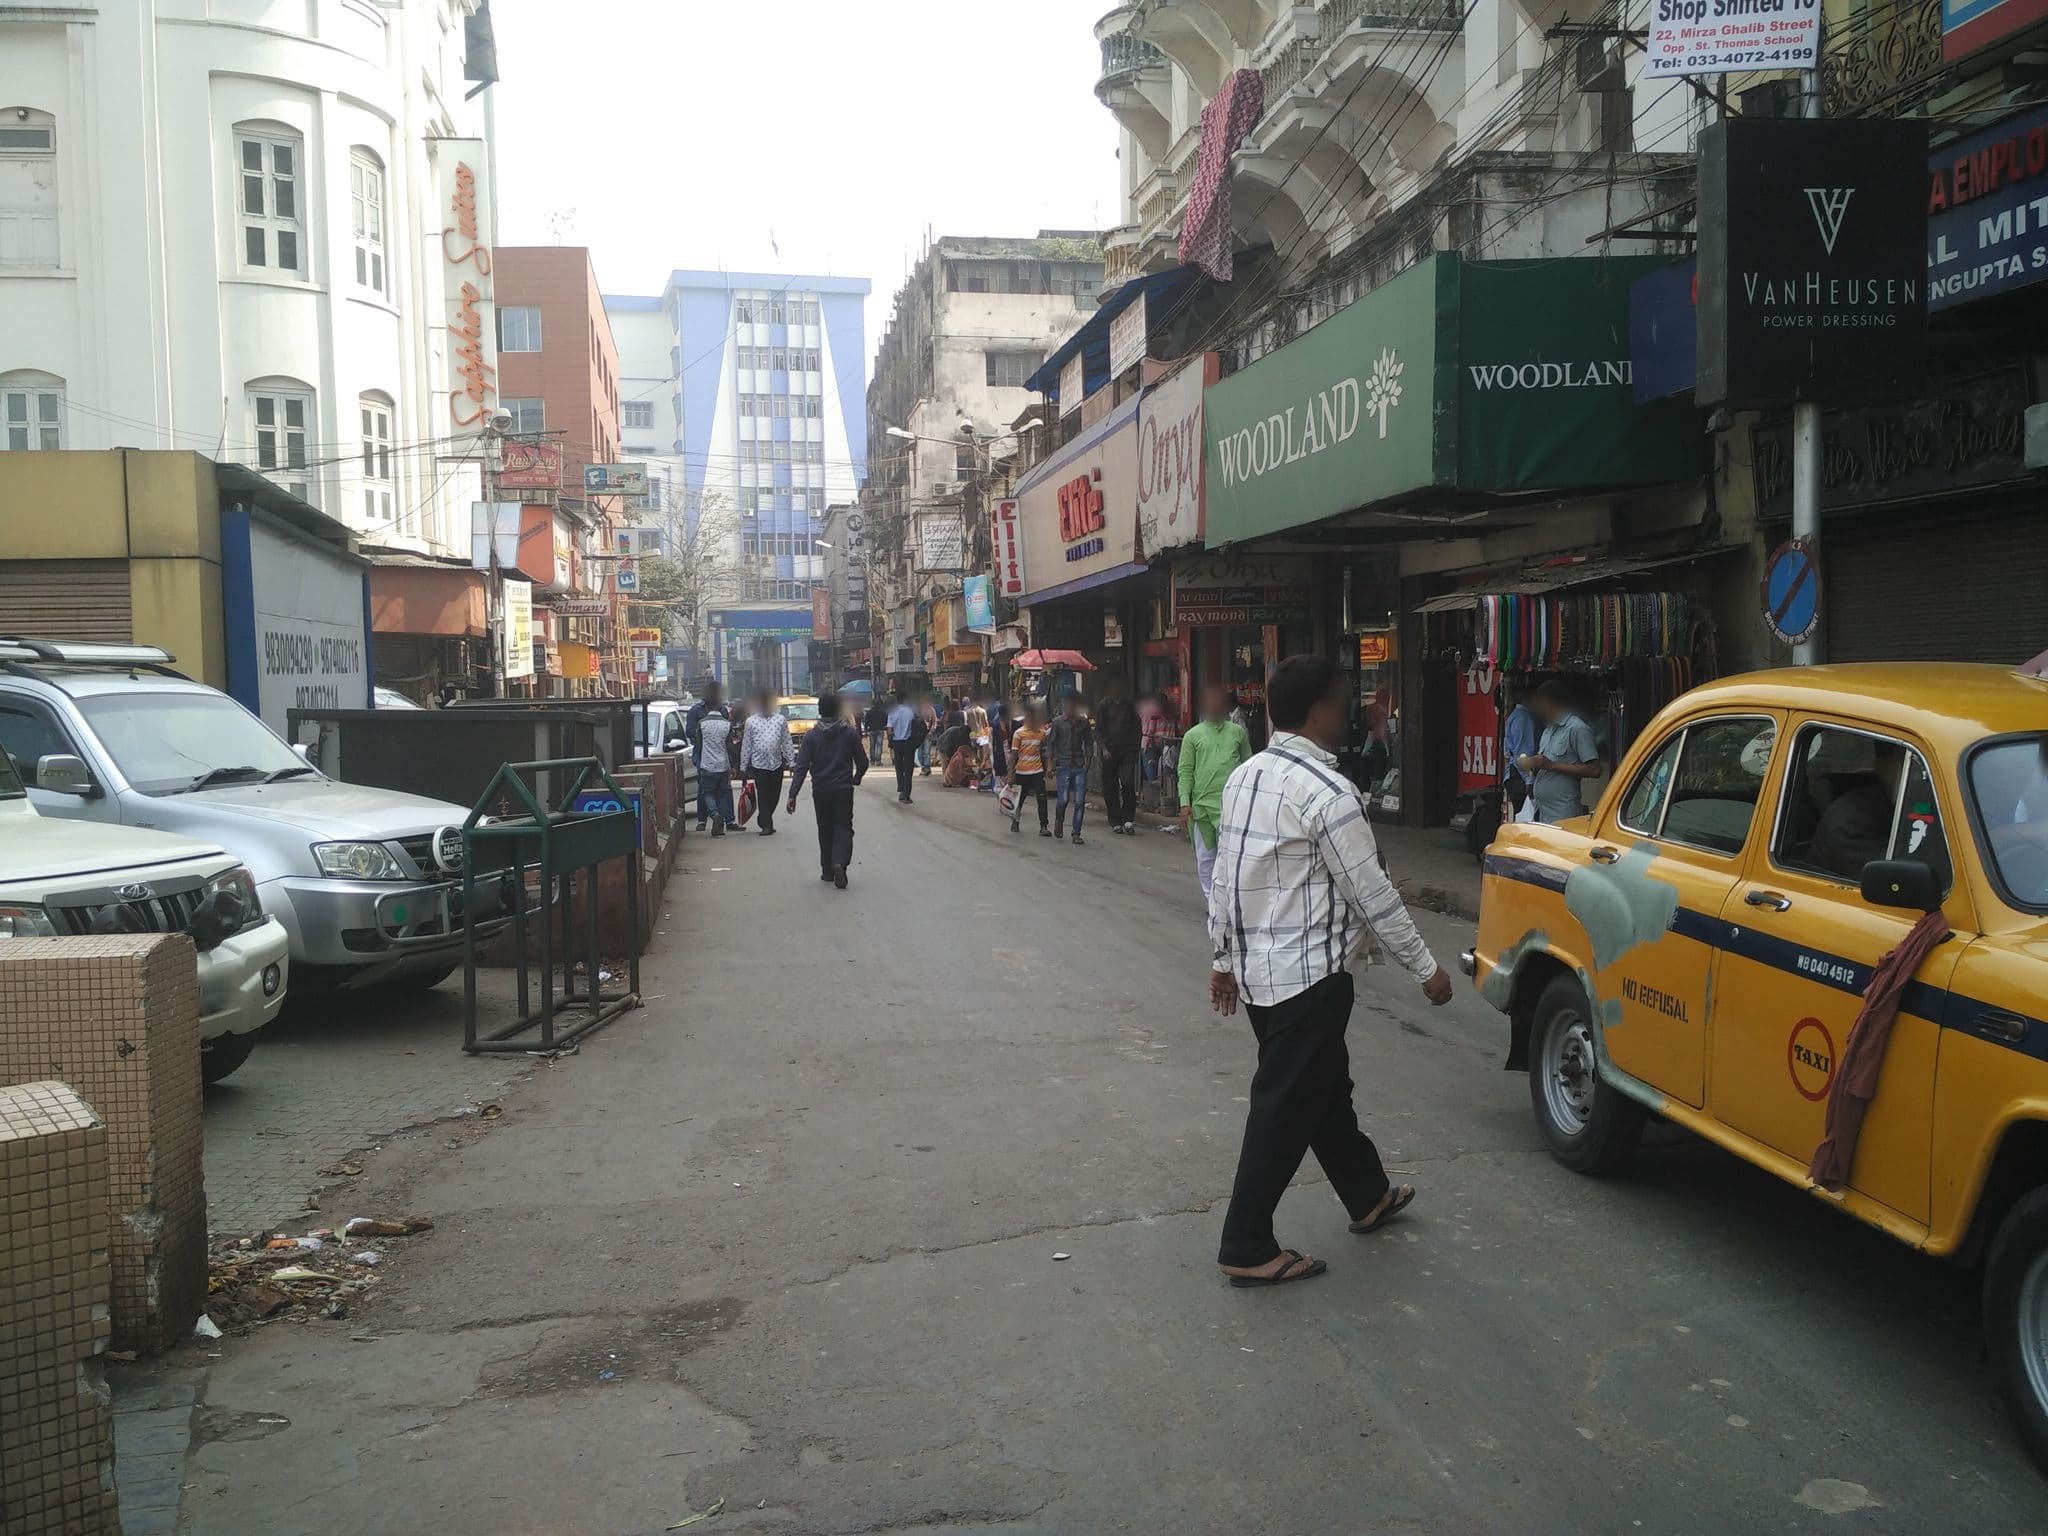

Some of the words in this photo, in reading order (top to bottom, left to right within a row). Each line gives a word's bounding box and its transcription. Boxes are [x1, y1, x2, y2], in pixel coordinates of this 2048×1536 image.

[1656, 30, 1676, 42] 22,
[1681, 26, 1717, 38] Mirza
[1721, 22, 1765, 36] Ghalib
[1769, 18, 1814, 32] Street
[1659, 0, 1706, 24] Shop
[1652, 57, 1682, 69] Tel:
[1687, 48, 1813, 67] 033-4072-4199
[1695, 42, 1711, 51] St.
[1715, 38, 1760, 49] Thomas
[1764, 34, 1804, 45] School
[1952, 124, 2048, 205] EMPLO
[441, 160, 491, 277] Suites
[1763, 315, 1814, 328] POWER
[1822, 313, 1897, 327] DRESSING
[449, 280, 496, 426] Sapphire
[1468, 360, 1633, 392] WOODLAN
[1217, 375, 1360, 489] WOODLAND
[1138, 404, 1200, 526] Onyx
[1057, 475, 1106, 543] Elite
[264, 631, 313, 676] 9830094290
[320, 637, 360, 674] 9874022116
[443, 844, 463, 855] Hella
[1622, 976, 1638, 1001] NO
[1639, 983, 1689, 1024] REFUSAL
[1793, 1043, 1830, 1074] TAXI
